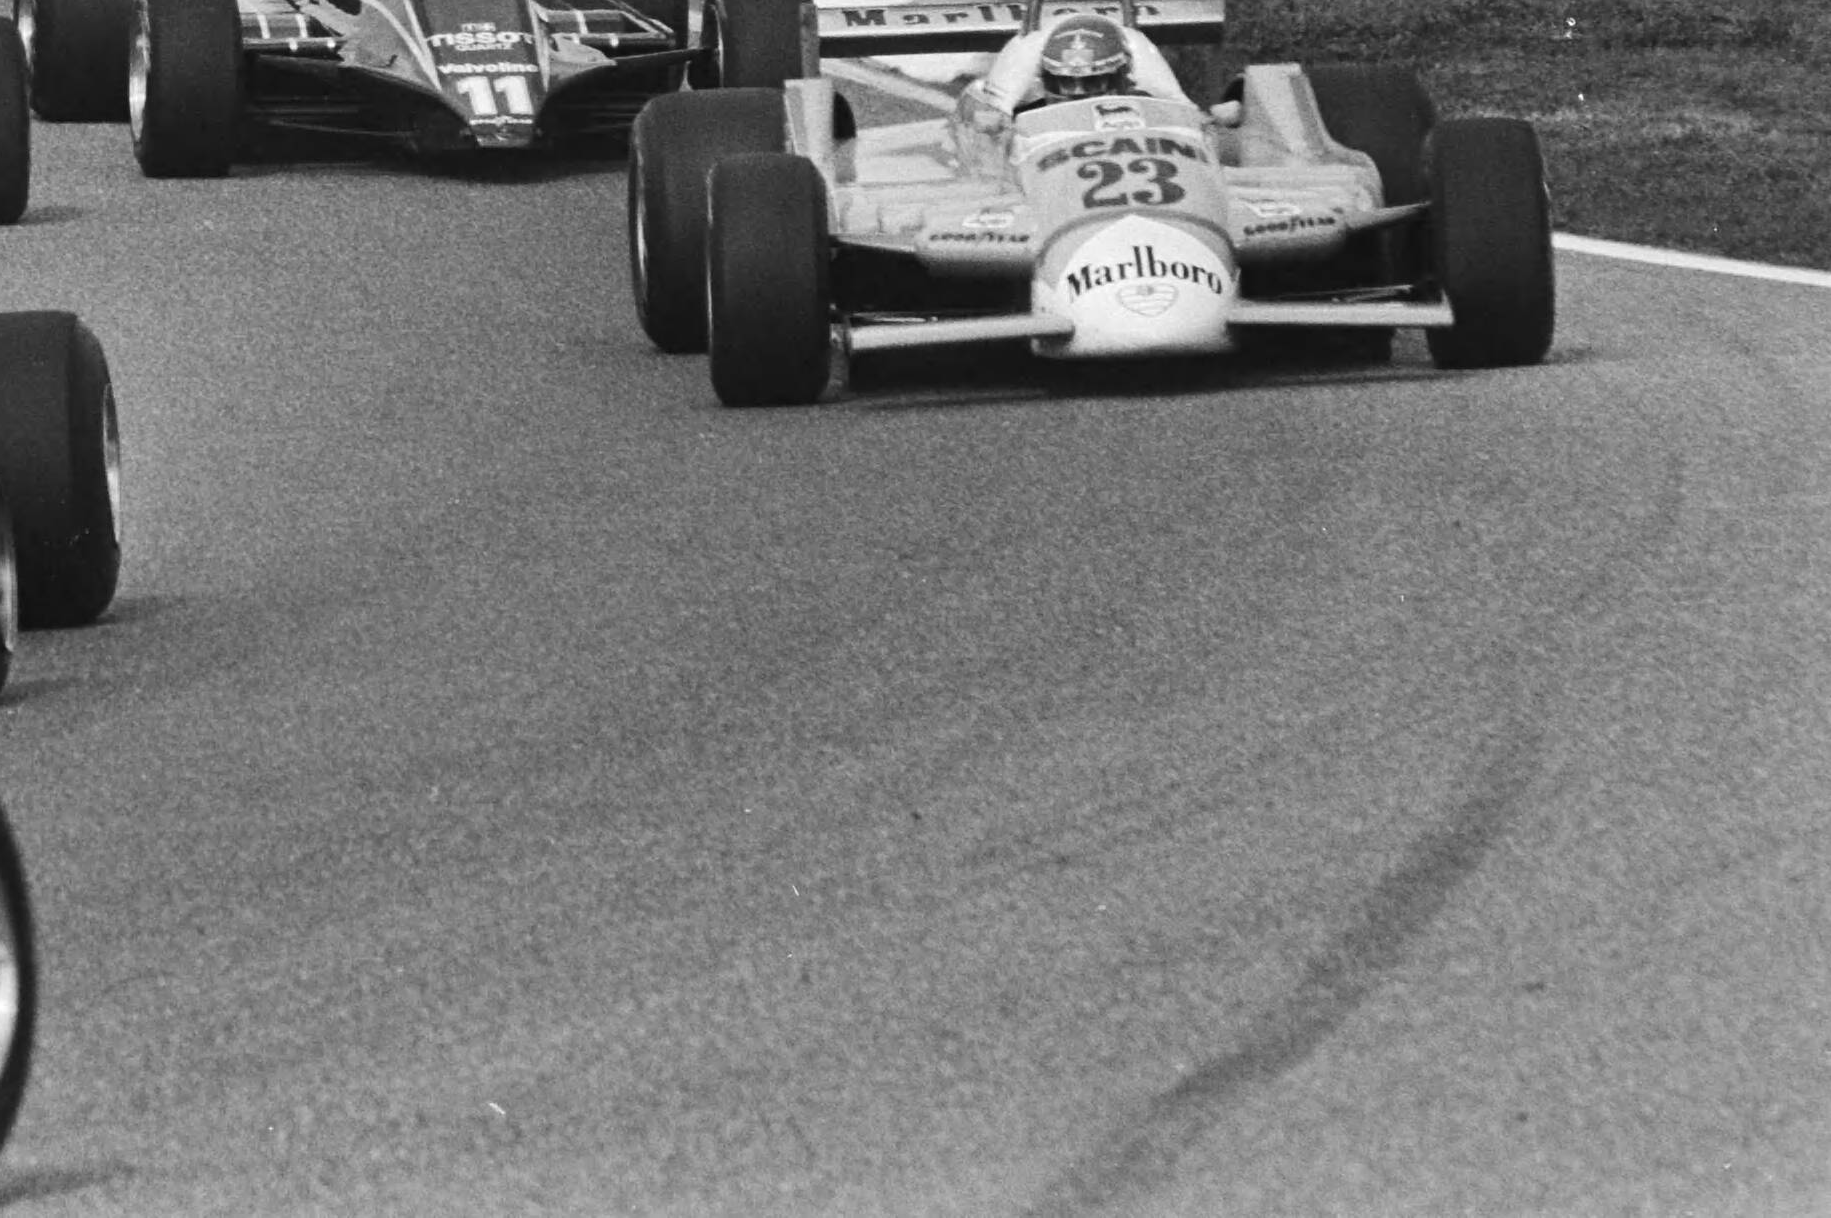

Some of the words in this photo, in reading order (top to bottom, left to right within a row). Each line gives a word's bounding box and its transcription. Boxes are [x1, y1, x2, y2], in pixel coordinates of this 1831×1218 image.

[456, 75, 534, 115] 11
[1076, 156, 1187, 210] 23
[1066, 245, 1223, 297] Marlboro
